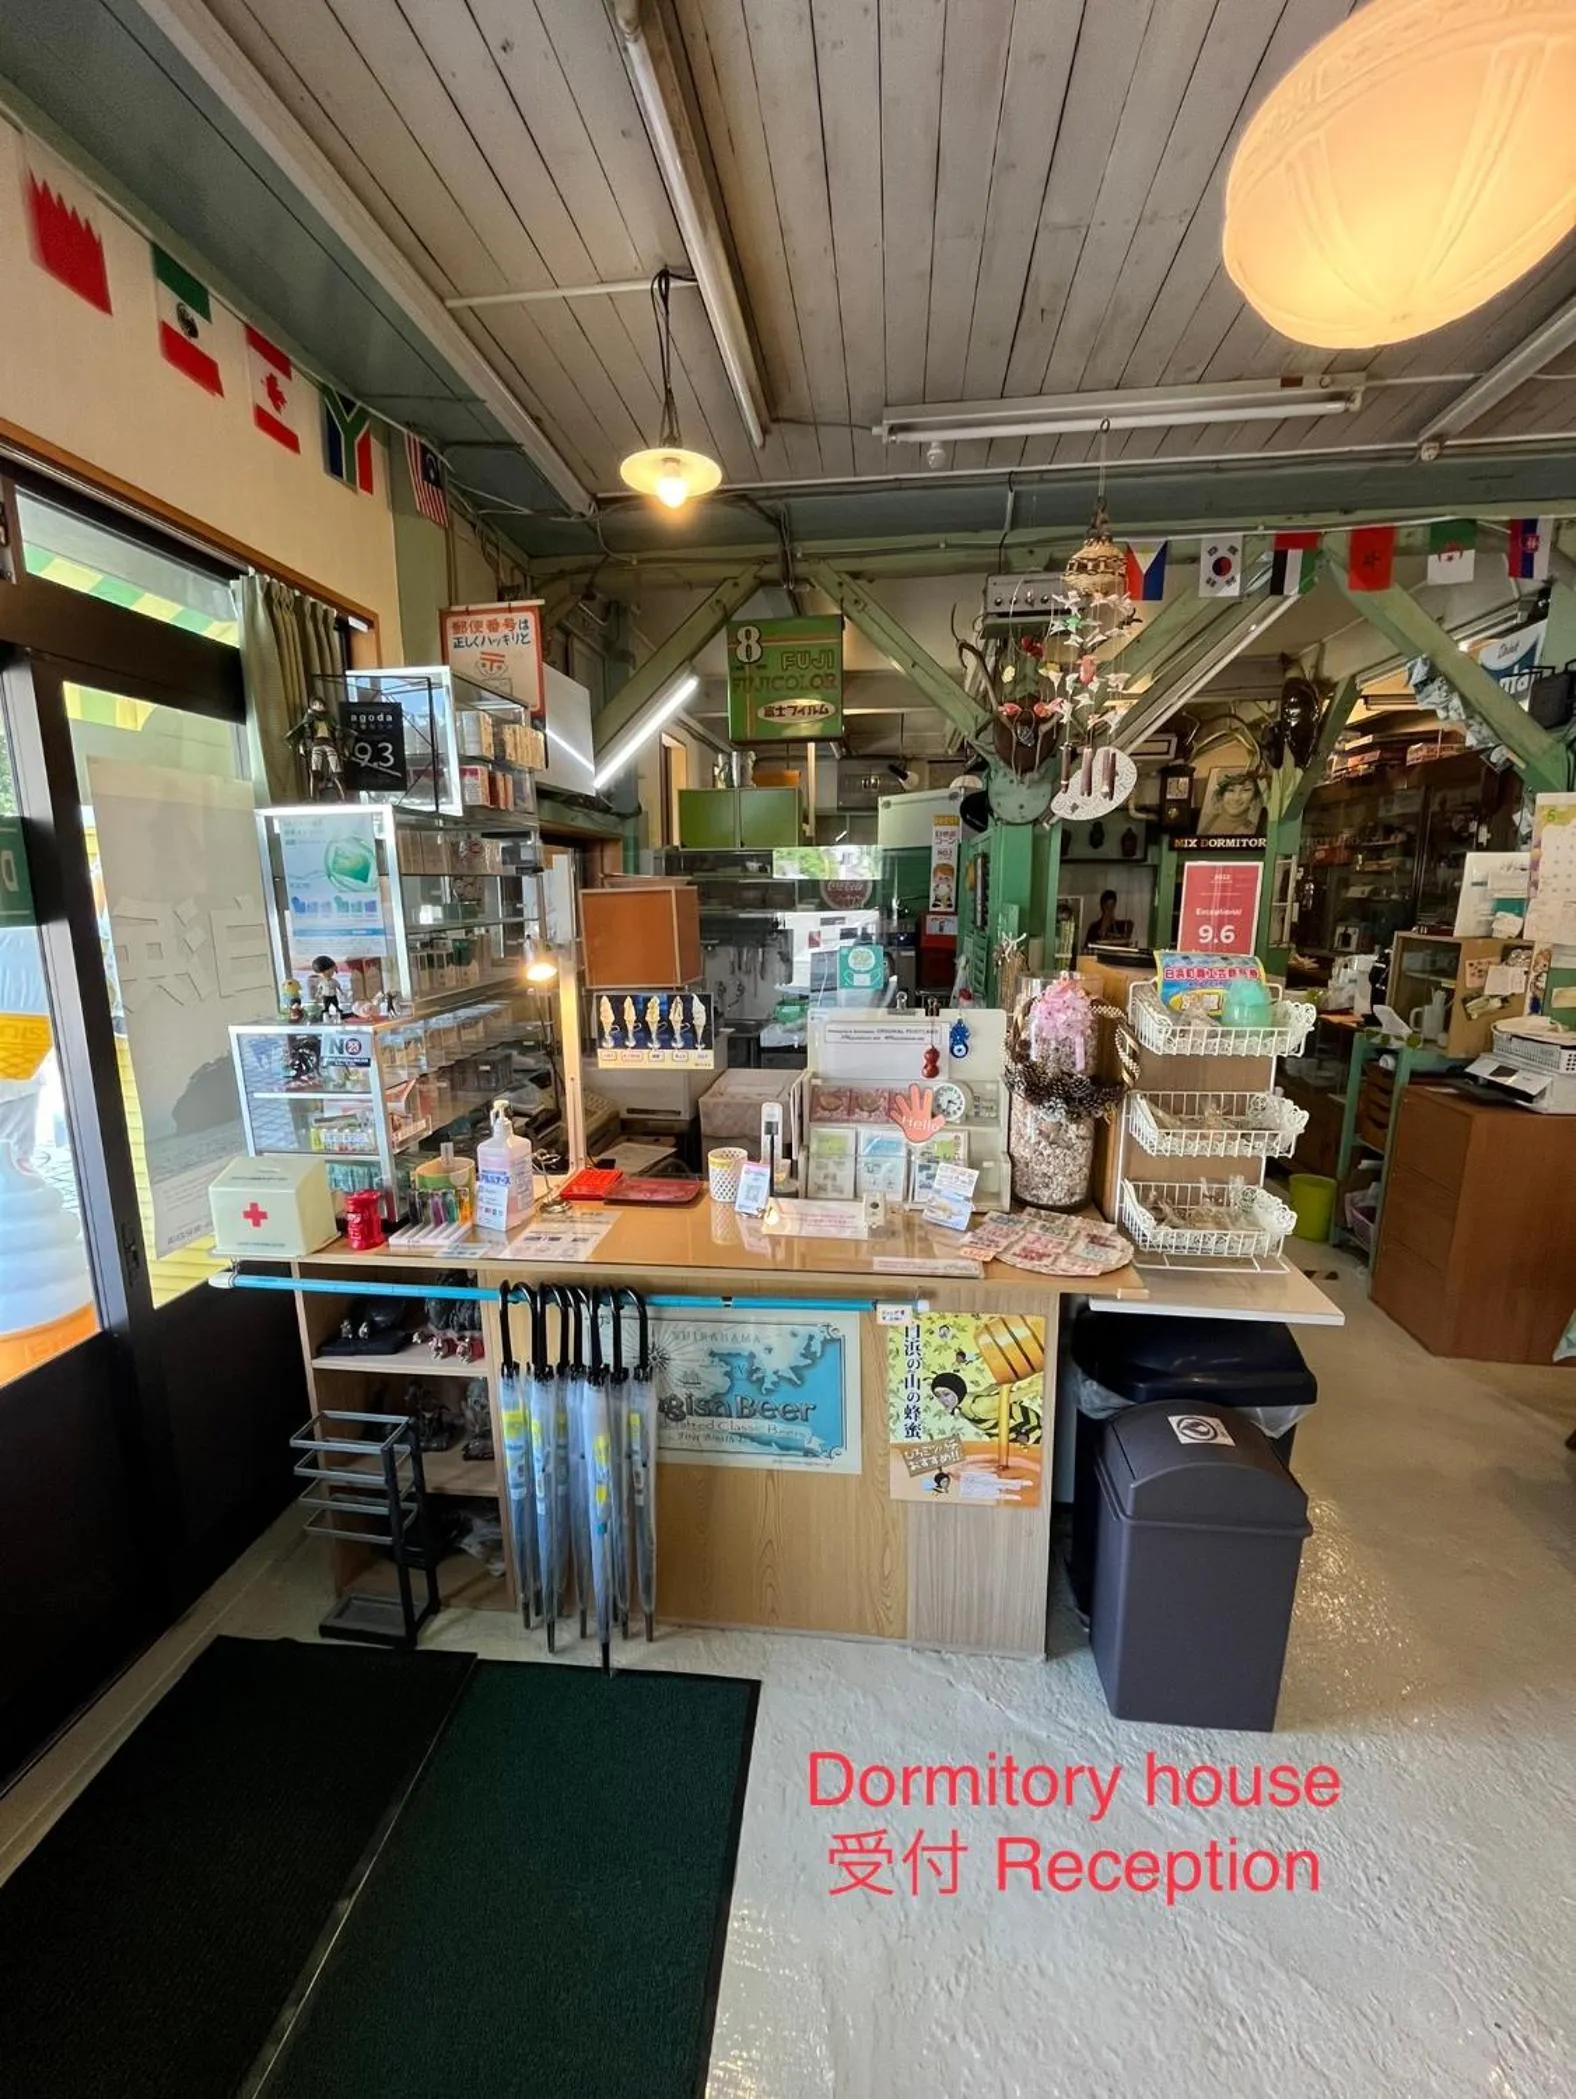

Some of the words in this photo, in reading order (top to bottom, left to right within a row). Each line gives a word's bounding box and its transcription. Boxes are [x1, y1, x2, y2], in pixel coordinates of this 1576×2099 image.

[452, 618, 530, 634] 郵便番号は
[453, 633, 531, 649] 正しくハッキリと
[736, 626, 762, 664] 8
[780, 649, 834, 671] FUJI
[732, 674, 838, 693] FUJICOLOR
[351, 712, 393, 723] agoda
[354, 742, 395, 767] 9.3
[1175, 838, 1198, 848] MIX
[1198, 924, 1236, 944] 9.6
[902, 1115, 941, 1131] Hello
[735, 1394, 817, 1423] Beer
